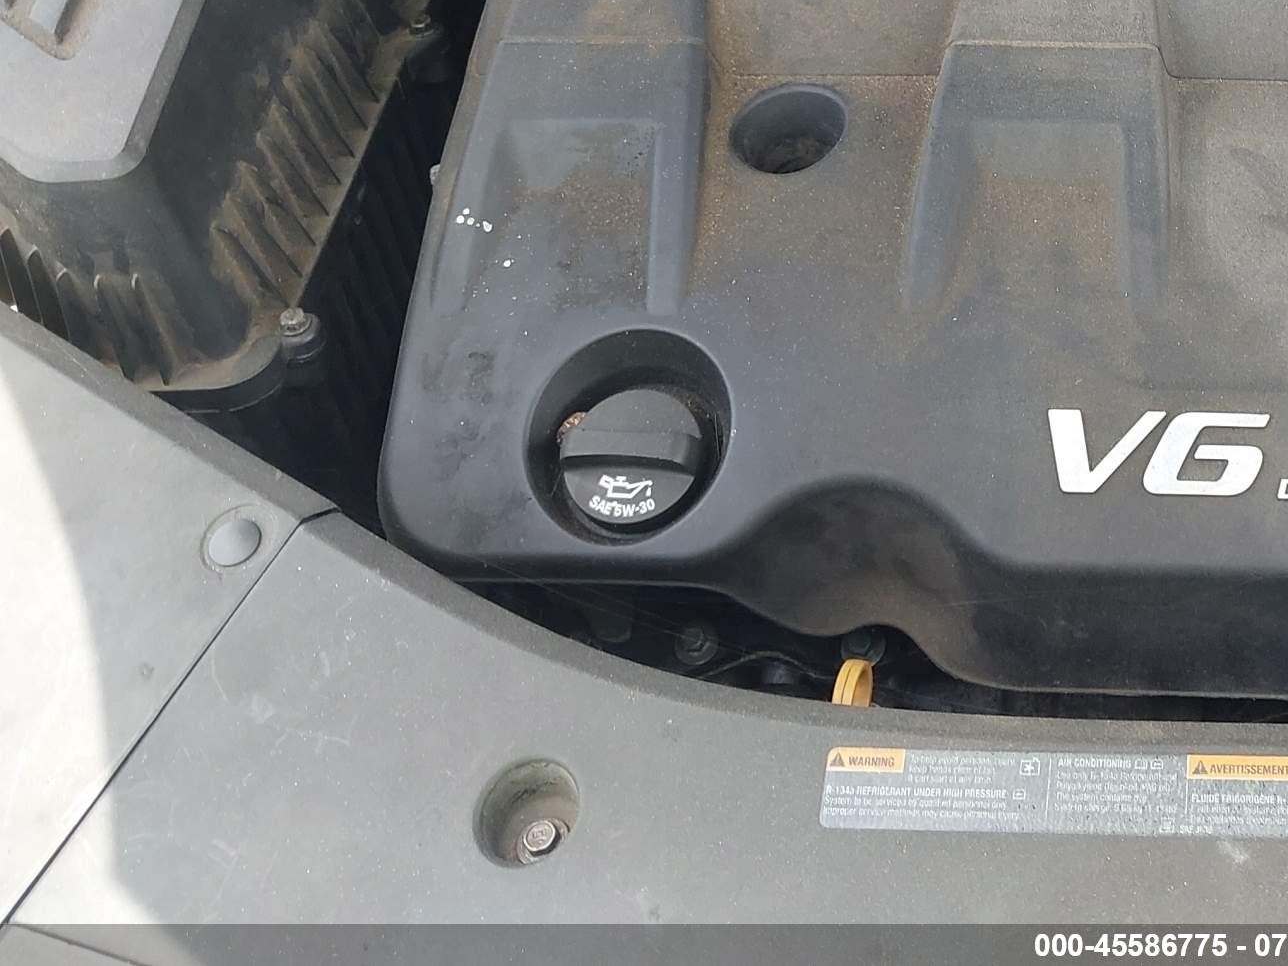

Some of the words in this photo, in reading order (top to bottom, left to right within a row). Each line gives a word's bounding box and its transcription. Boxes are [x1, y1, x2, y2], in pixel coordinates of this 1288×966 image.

[1047, 408, 1271, 497] V6
[589, 495, 613, 515] SAE
[613, 498, 655, 517] 5W-30
[848, 755, 895, 767] WARNING
[1058, 758, 1071, 767] AIR
[1074, 758, 1131, 769] CONDITIONING
[856, 787, 912, 798] REFRIGERANT
[914, 788, 941, 799] UNDER
[964, 789, 1007, 800] PRESSURE
[1192, 793, 1219, 803] FLUIDE
